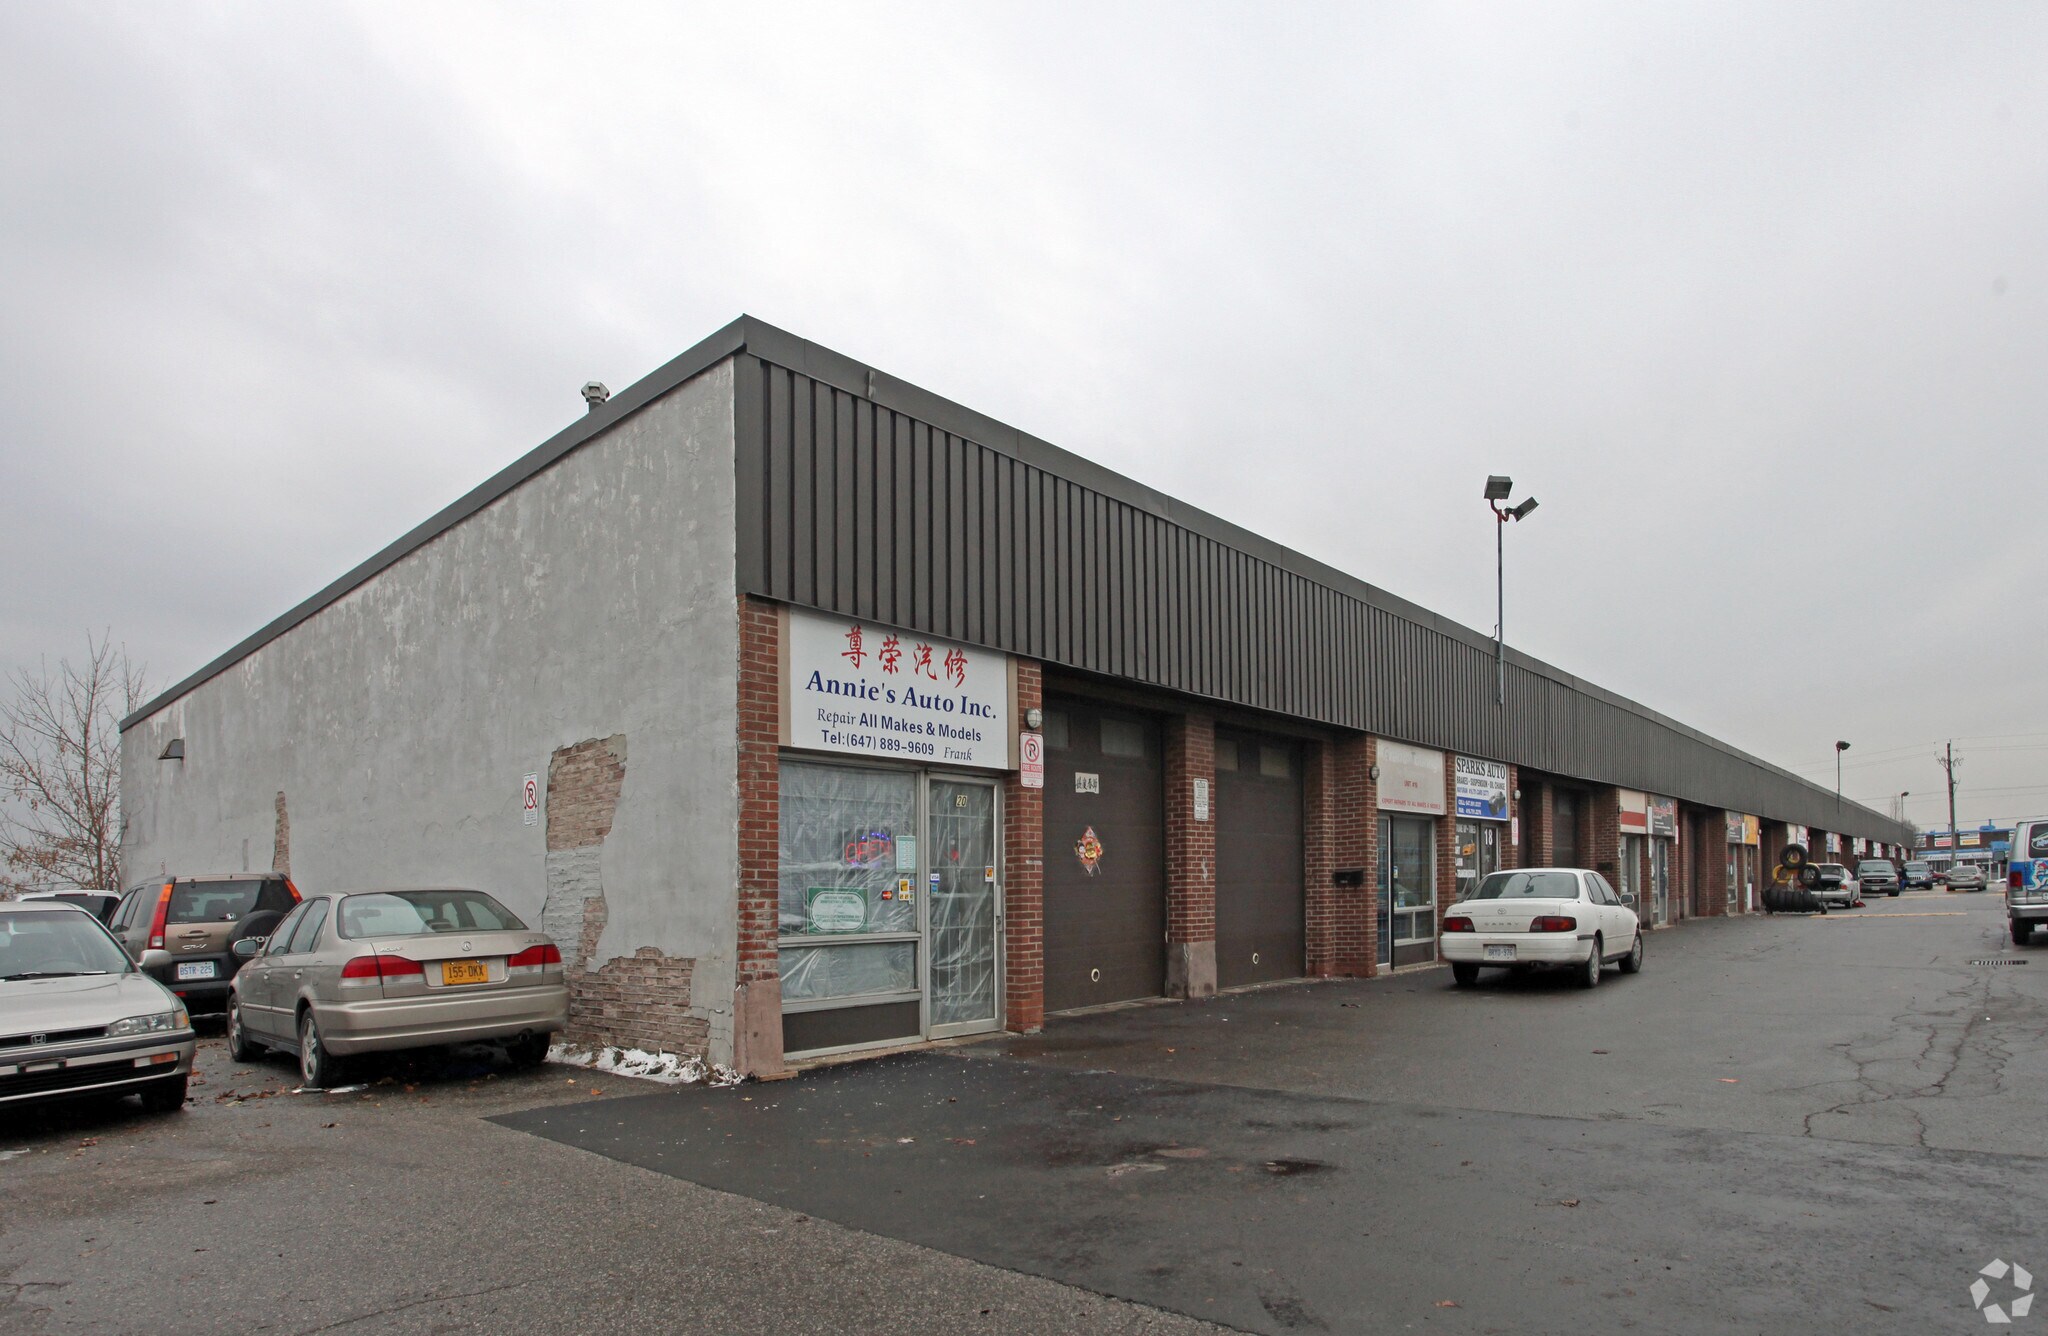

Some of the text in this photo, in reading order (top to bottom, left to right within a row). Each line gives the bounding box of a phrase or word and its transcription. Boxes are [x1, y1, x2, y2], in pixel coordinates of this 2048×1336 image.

[805, 670, 997, 719] Annie's Auto Inc.
[817, 708, 982, 741] Repair All Makes & Models
[880, 738, 934, 755] 889-9609
[944, 747, 972, 760] Frank
[1022, 764, 1030, 772] FIRE
[1456, 757, 1486, 776] SPARKS
[1486, 763, 1506, 780] AUTO
[958, 796, 966, 806] 20
[1484, 829, 1492, 846] 18
